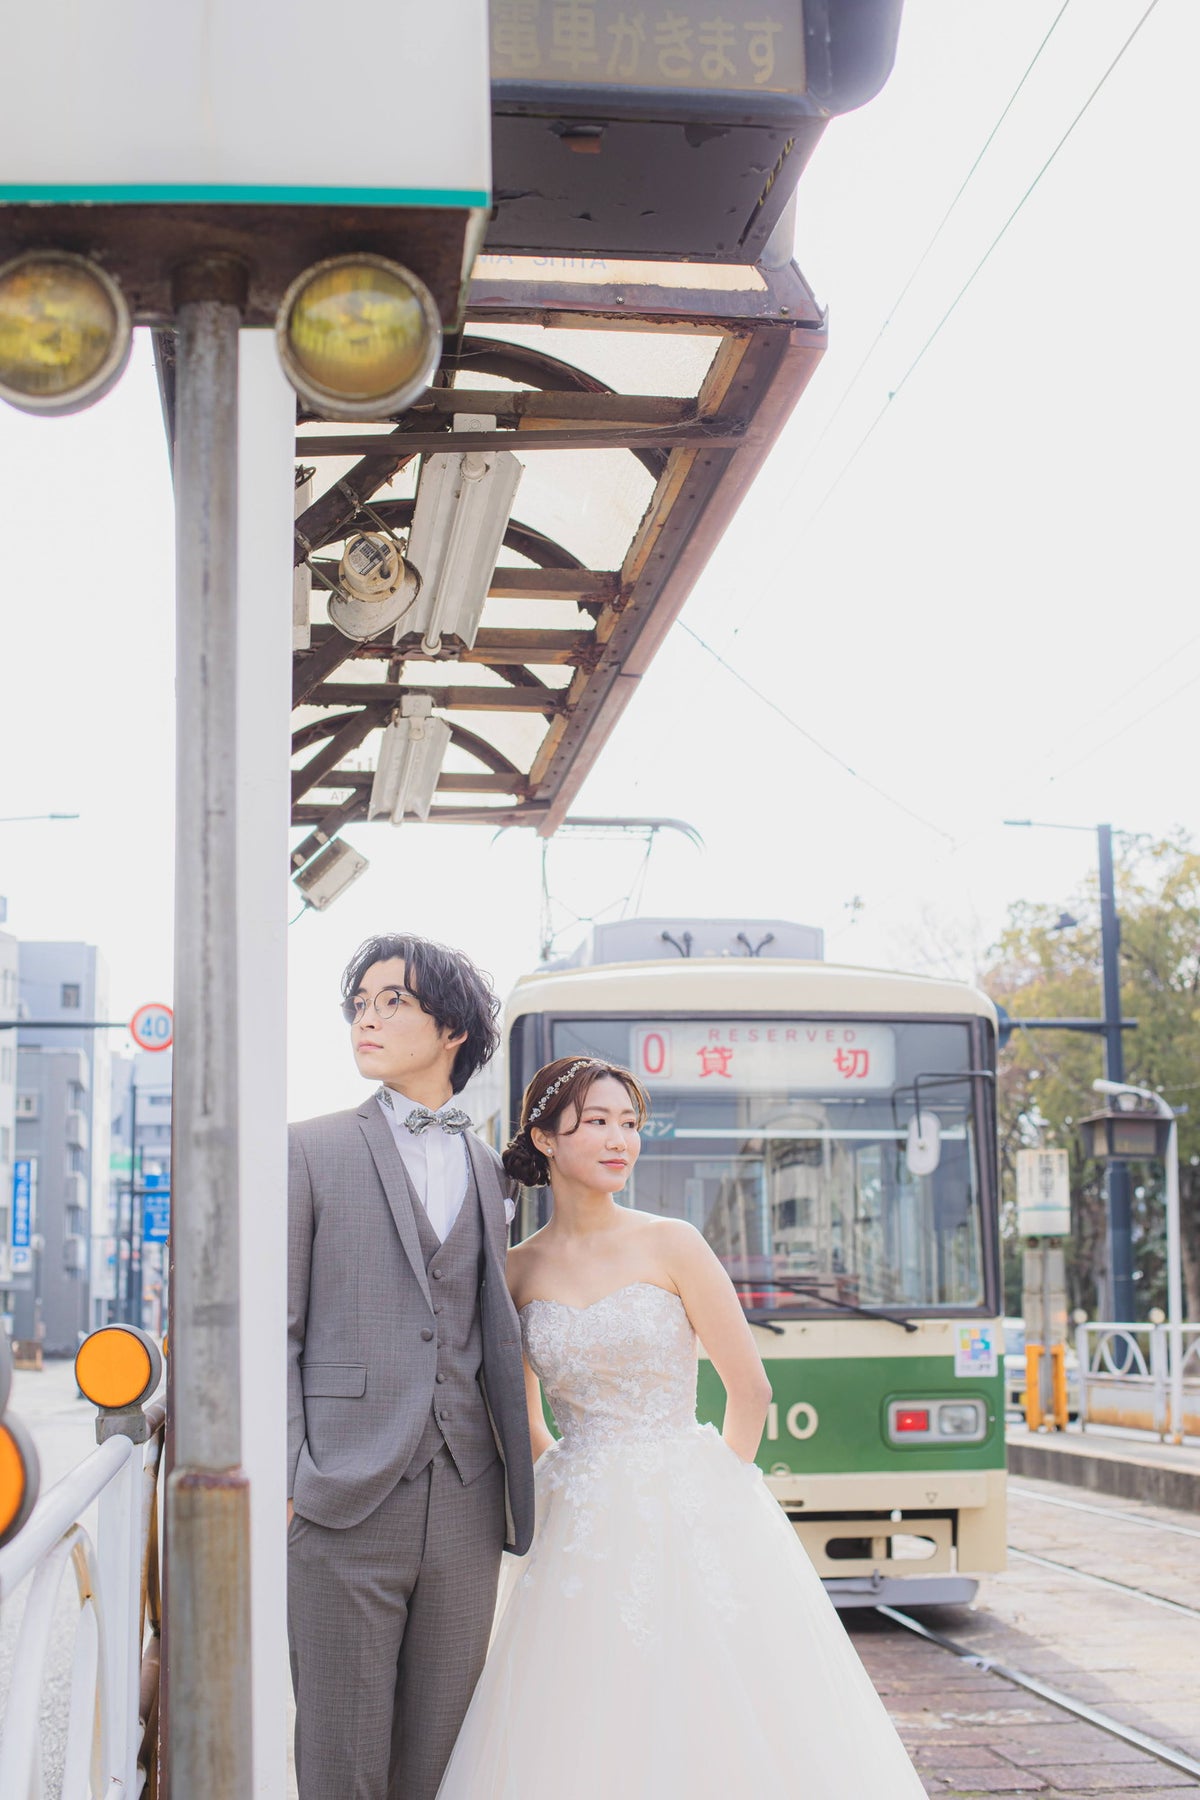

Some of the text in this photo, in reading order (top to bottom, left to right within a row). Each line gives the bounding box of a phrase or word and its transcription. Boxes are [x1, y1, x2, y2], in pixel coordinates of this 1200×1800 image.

[493, 0, 782, 84] 電車がきます
[140, 1016, 169, 1039] 40
[708, 1028, 856, 1043] RESERVED
[643, 1034, 666, 1075] 0
